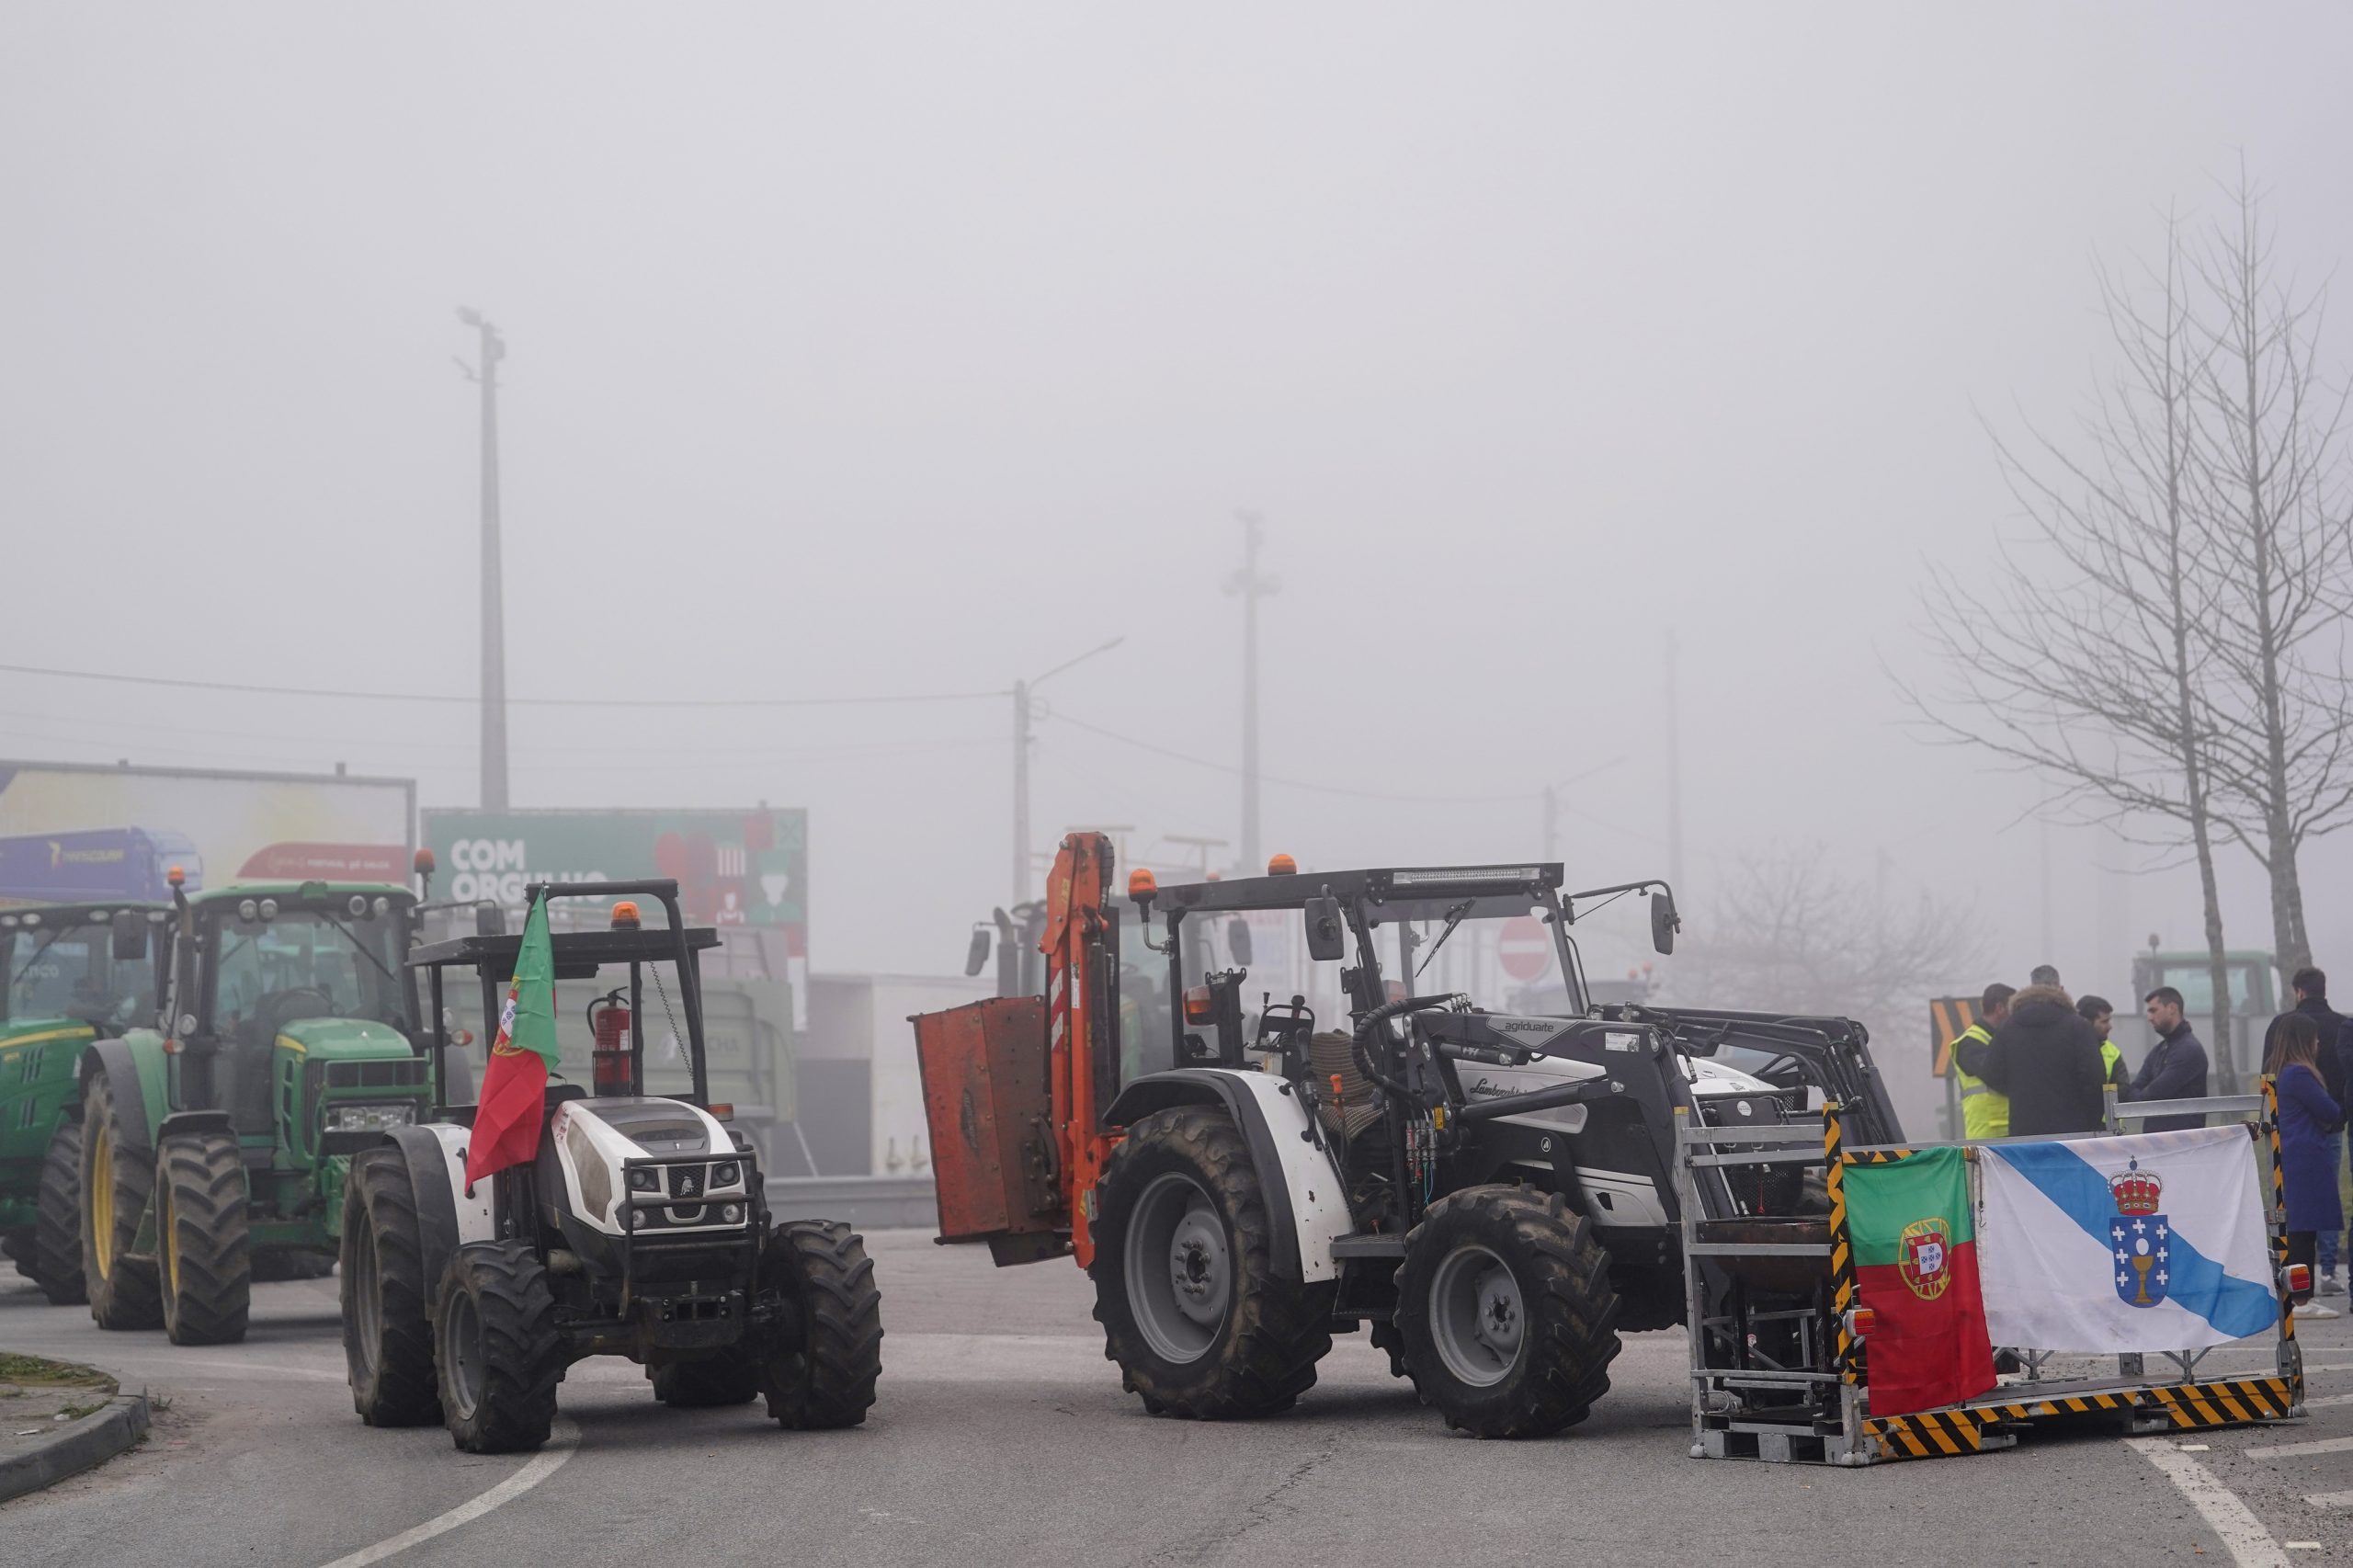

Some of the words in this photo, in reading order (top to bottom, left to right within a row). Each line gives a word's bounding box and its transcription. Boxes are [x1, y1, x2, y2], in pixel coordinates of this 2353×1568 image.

[450, 838, 526, 871] COM
[1505, 1021, 1554, 1033] agriduarte
[1469, 1077, 1528, 1097] Lamborghi
